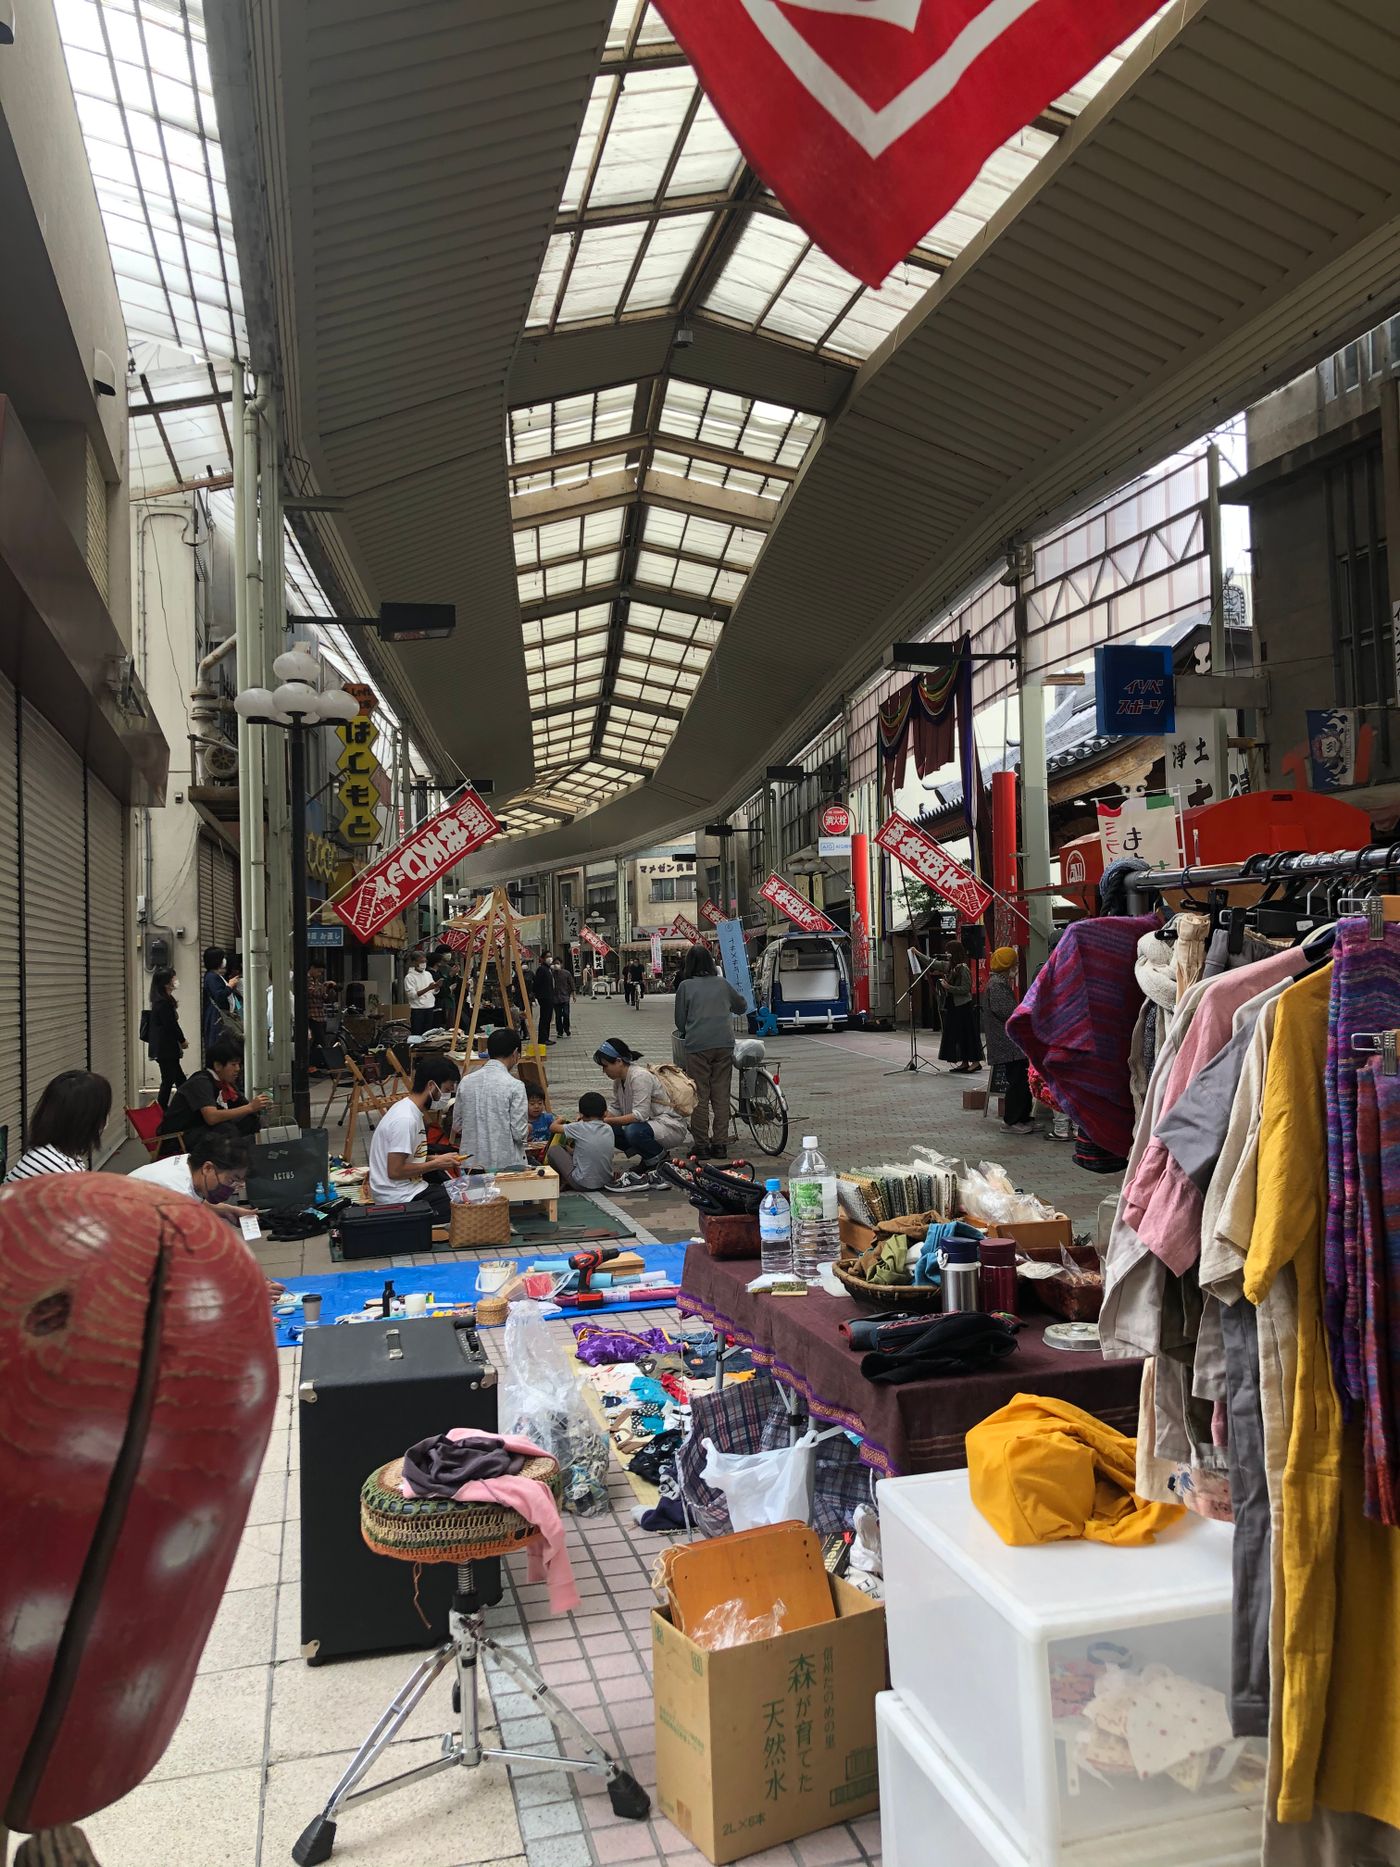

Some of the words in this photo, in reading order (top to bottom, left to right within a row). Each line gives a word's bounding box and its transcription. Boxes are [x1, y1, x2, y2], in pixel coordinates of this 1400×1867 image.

[1123, 679, 1164, 694] イソベ
[1116, 699, 1165, 715] スポーツ
[825, 815, 847, 826] 消火栓
[640, 863, 674, 874] マメゼン
[658, 927, 679, 937] マメ
[273, 1170, 295, 1181] ACTUS
[787, 1652, 817, 1793] 森が育てた
[762, 1698, 787, 1801] 天然水
